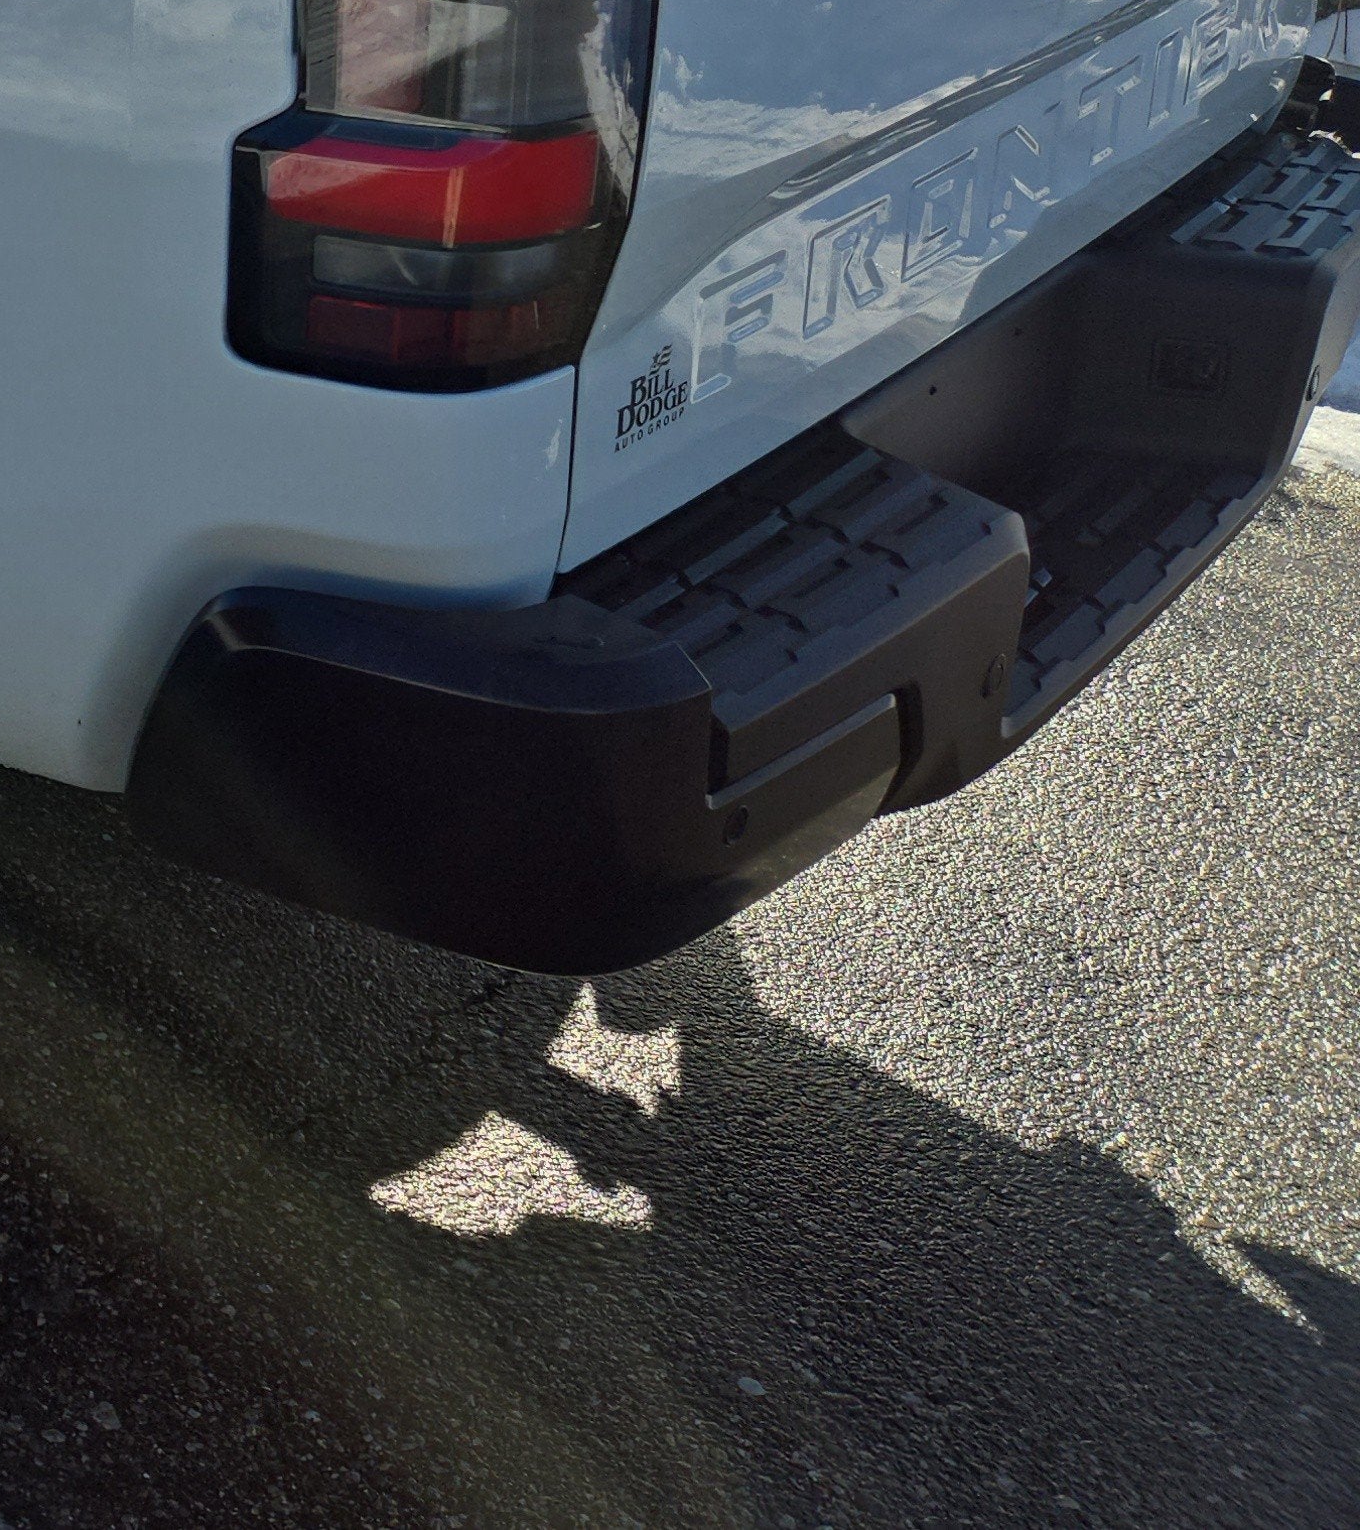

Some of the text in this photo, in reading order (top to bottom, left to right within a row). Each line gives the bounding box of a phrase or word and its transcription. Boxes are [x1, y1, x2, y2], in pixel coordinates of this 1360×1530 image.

[615, 381, 688, 439] DODGE
[631, 368, 674, 407] BILL
[614, 406, 685, 453] AUTO GROUP
